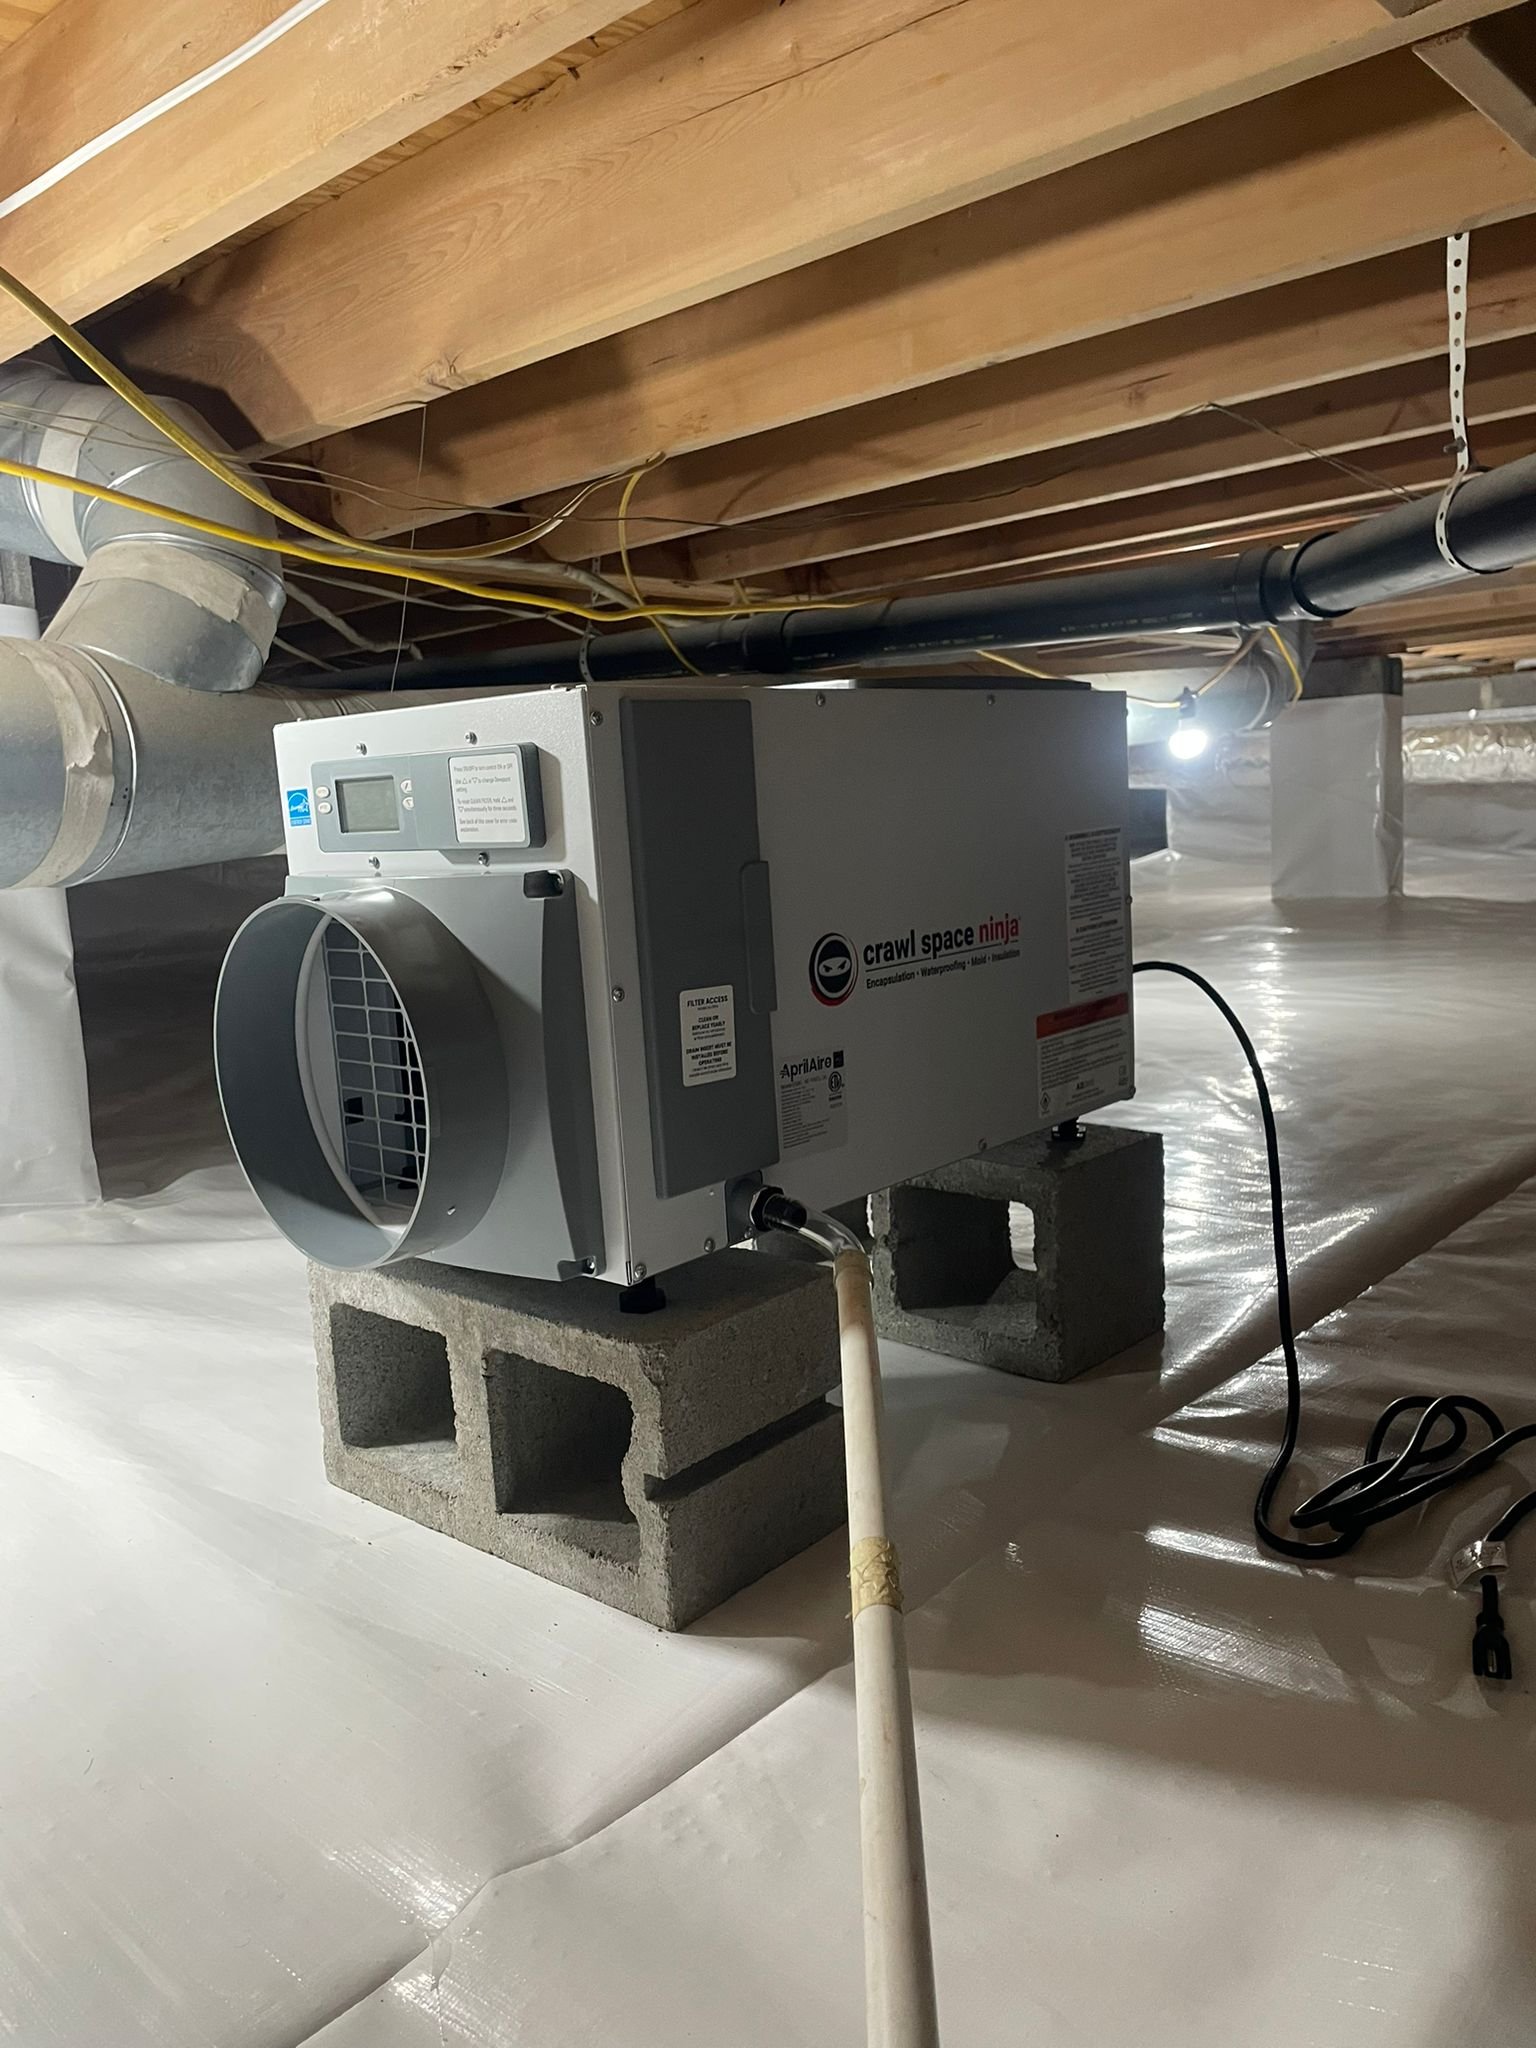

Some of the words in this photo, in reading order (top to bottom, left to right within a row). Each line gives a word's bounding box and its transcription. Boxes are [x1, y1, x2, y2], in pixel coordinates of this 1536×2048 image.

[864, 929, 915, 966] crawl
[922, 926, 974, 959] space
[978, 913, 1019, 944] ninja
[866, 970, 915, 989] Encapsulation
[921, 960, 966, 977] Waterproofing
[971, 954, 986, 966] Mold
[992, 950, 1020, 962] Insulation
[687, 998, 704, 1007] FILTER
[706, 995, 728, 1004] ACCESS
[780, 1056, 832, 1081] AprilAire
